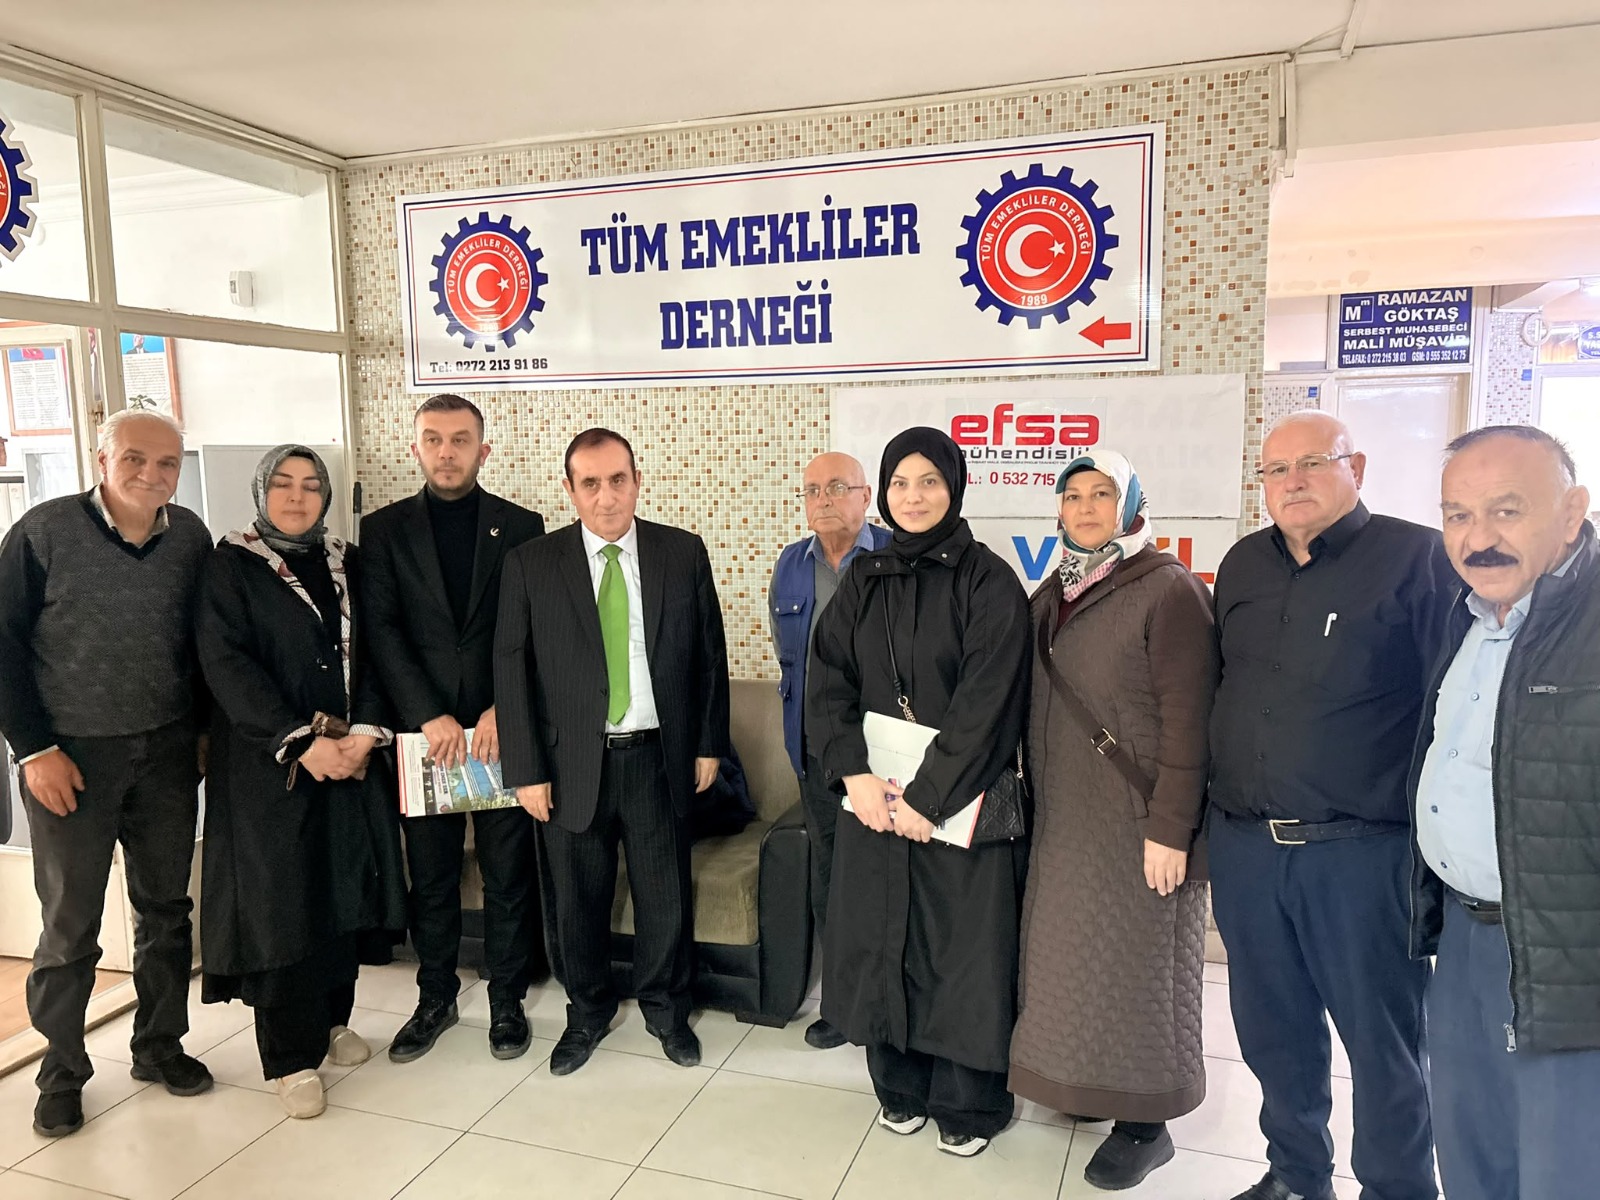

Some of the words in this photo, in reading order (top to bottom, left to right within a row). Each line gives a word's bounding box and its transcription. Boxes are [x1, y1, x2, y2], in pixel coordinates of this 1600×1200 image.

[581, 212, 668, 275] TÜM
[680, 194, 920, 270] EMEKLİLER
[980, 232, 994, 261] TÜM
[991, 194, 1057, 230] EMEKLİLER
[1059, 201, 1091, 255] DERNEĞİ
[447, 269, 457, 294] TÜM
[454, 237, 501, 268] EMEKLİLER
[503, 244, 529, 290] DERNEĞİ
[1020, 293, 1048, 306] 1989
[1378, 289, 1468, 306] RAMAZAN
[659, 278, 832, 350] DERNEĞİ
[1384, 307, 1459, 323] GÖKTAŞ
[1343, 326, 1393, 337] SERBEST
[1395, 322, 1468, 335] MUHASEBECİ
[1343, 336, 1384, 350] MALİ
[1372, 352, 1381, 363] 272
[429, 361, 452, 373] Tel:
[455, 360, 486, 372] 0272
[489, 359, 511, 371] 213
[514, 358, 529, 370] 91
[532, 358, 548, 370] 86
[950, 403, 1100, 446] efsa
[960, 446, 1090, 461] ühendisli
[990, 472, 999, 485] 0
[1002, 472, 1029, 485] 532
[1032, 473, 1056, 486] 715
